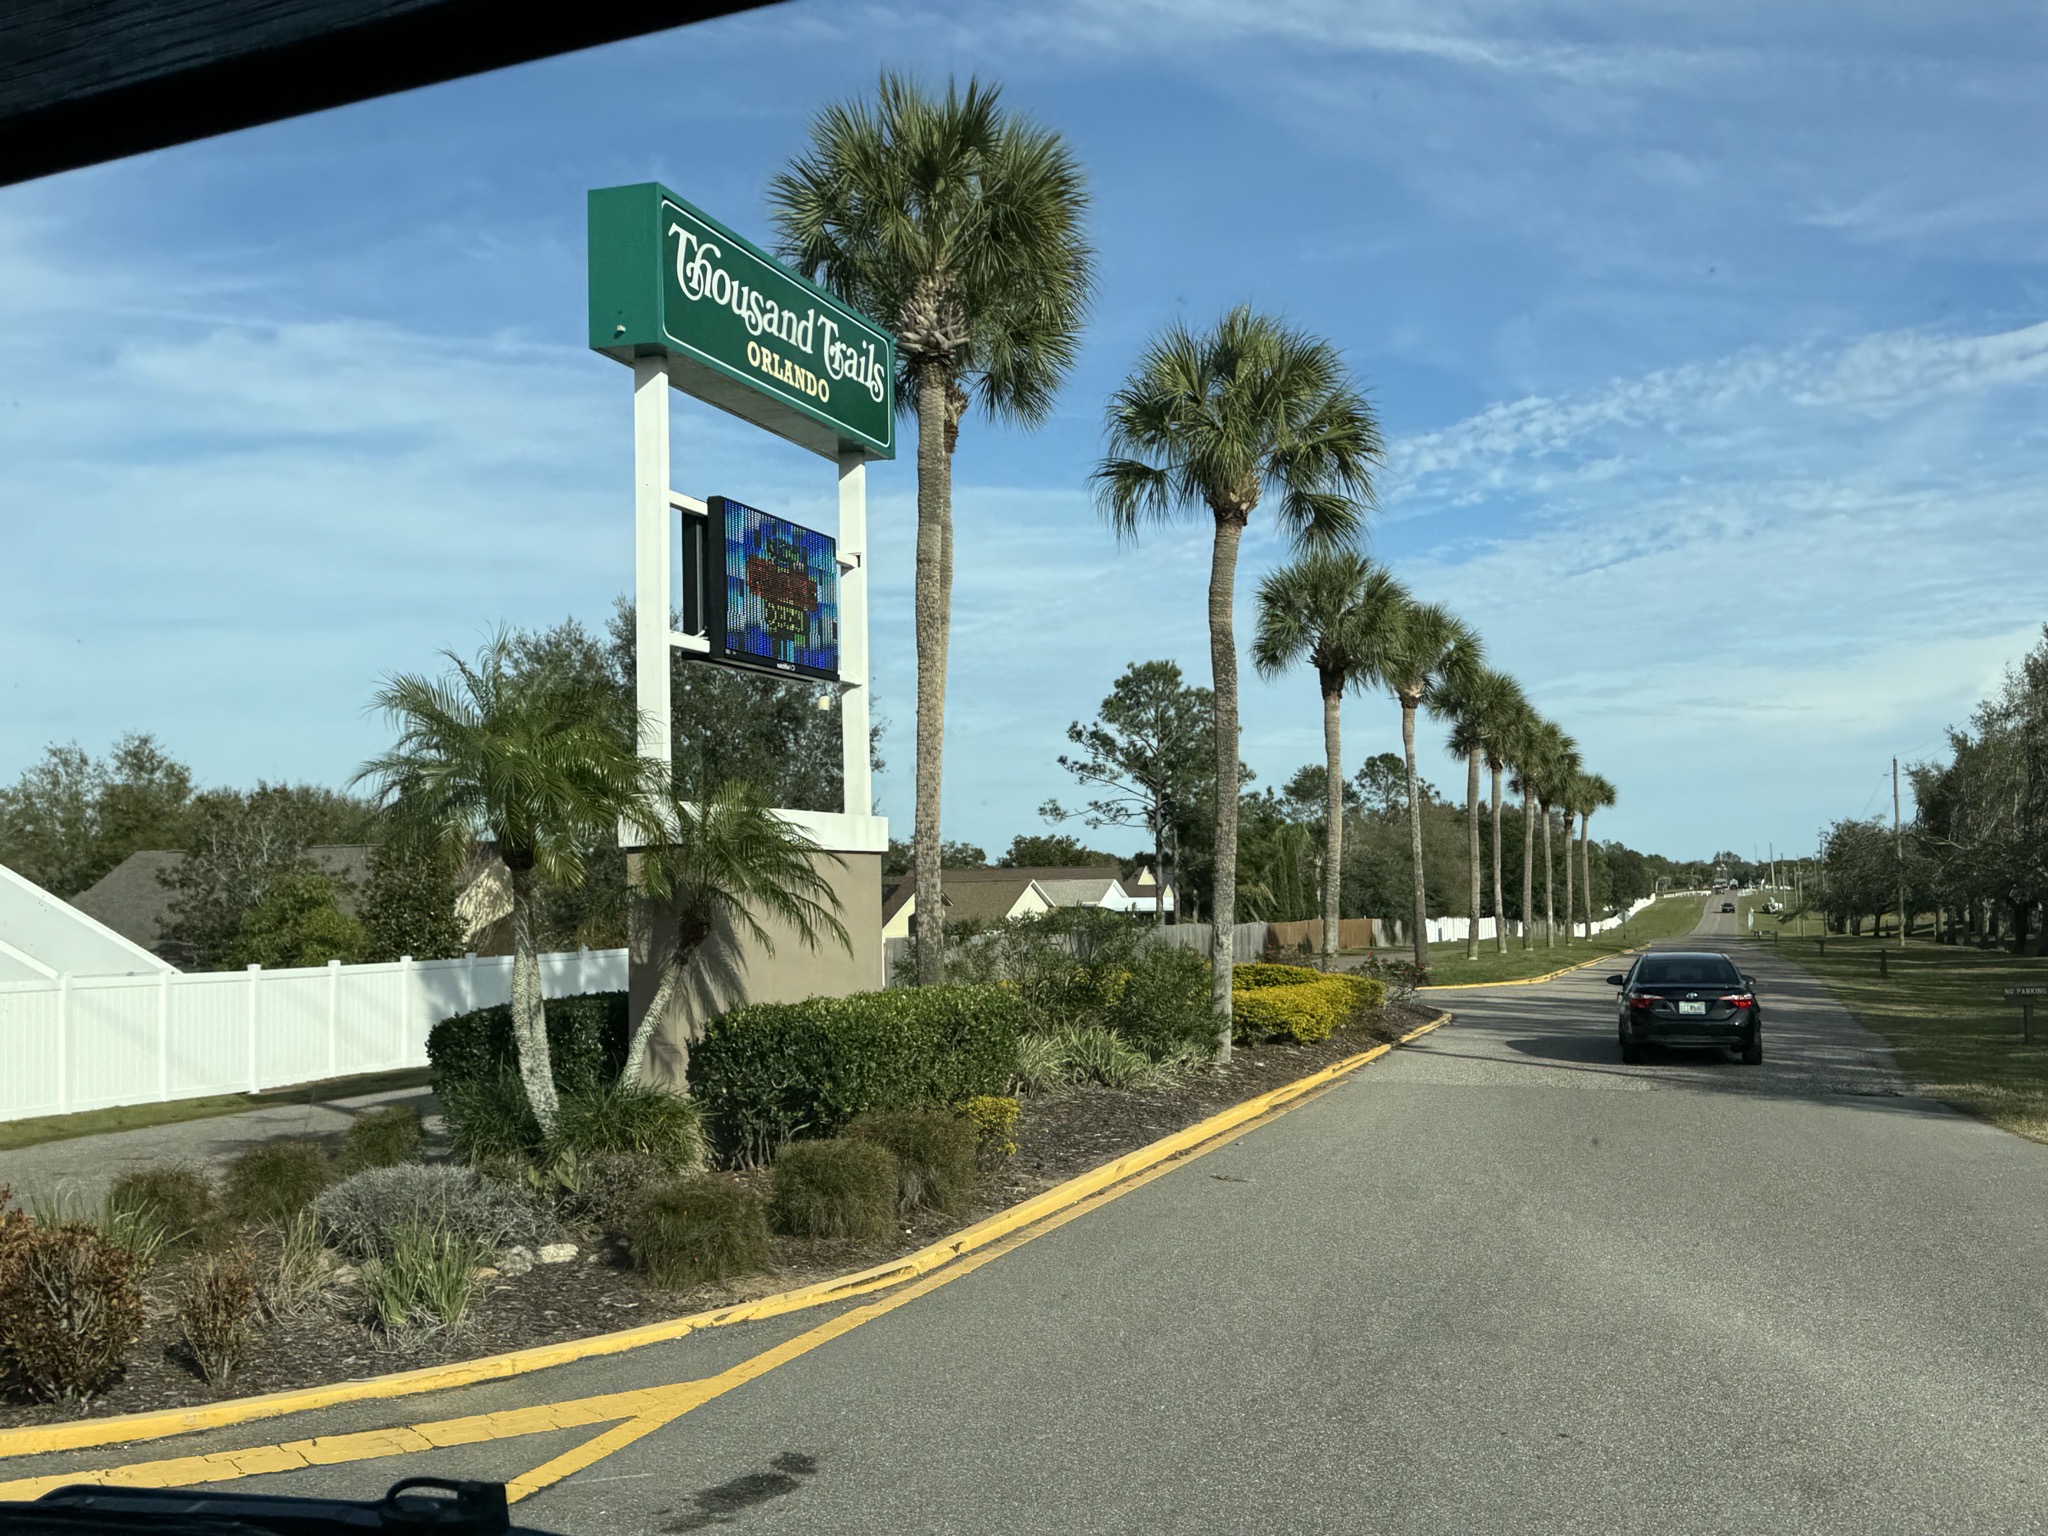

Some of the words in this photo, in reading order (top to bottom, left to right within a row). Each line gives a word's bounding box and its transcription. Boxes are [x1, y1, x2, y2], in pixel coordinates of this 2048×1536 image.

[668, 223, 814, 354] Thousand
[817, 314, 885, 402] Trails
[747, 341, 830, 403] ORLANDO
[2016, 987, 2048, 995] PARKING
